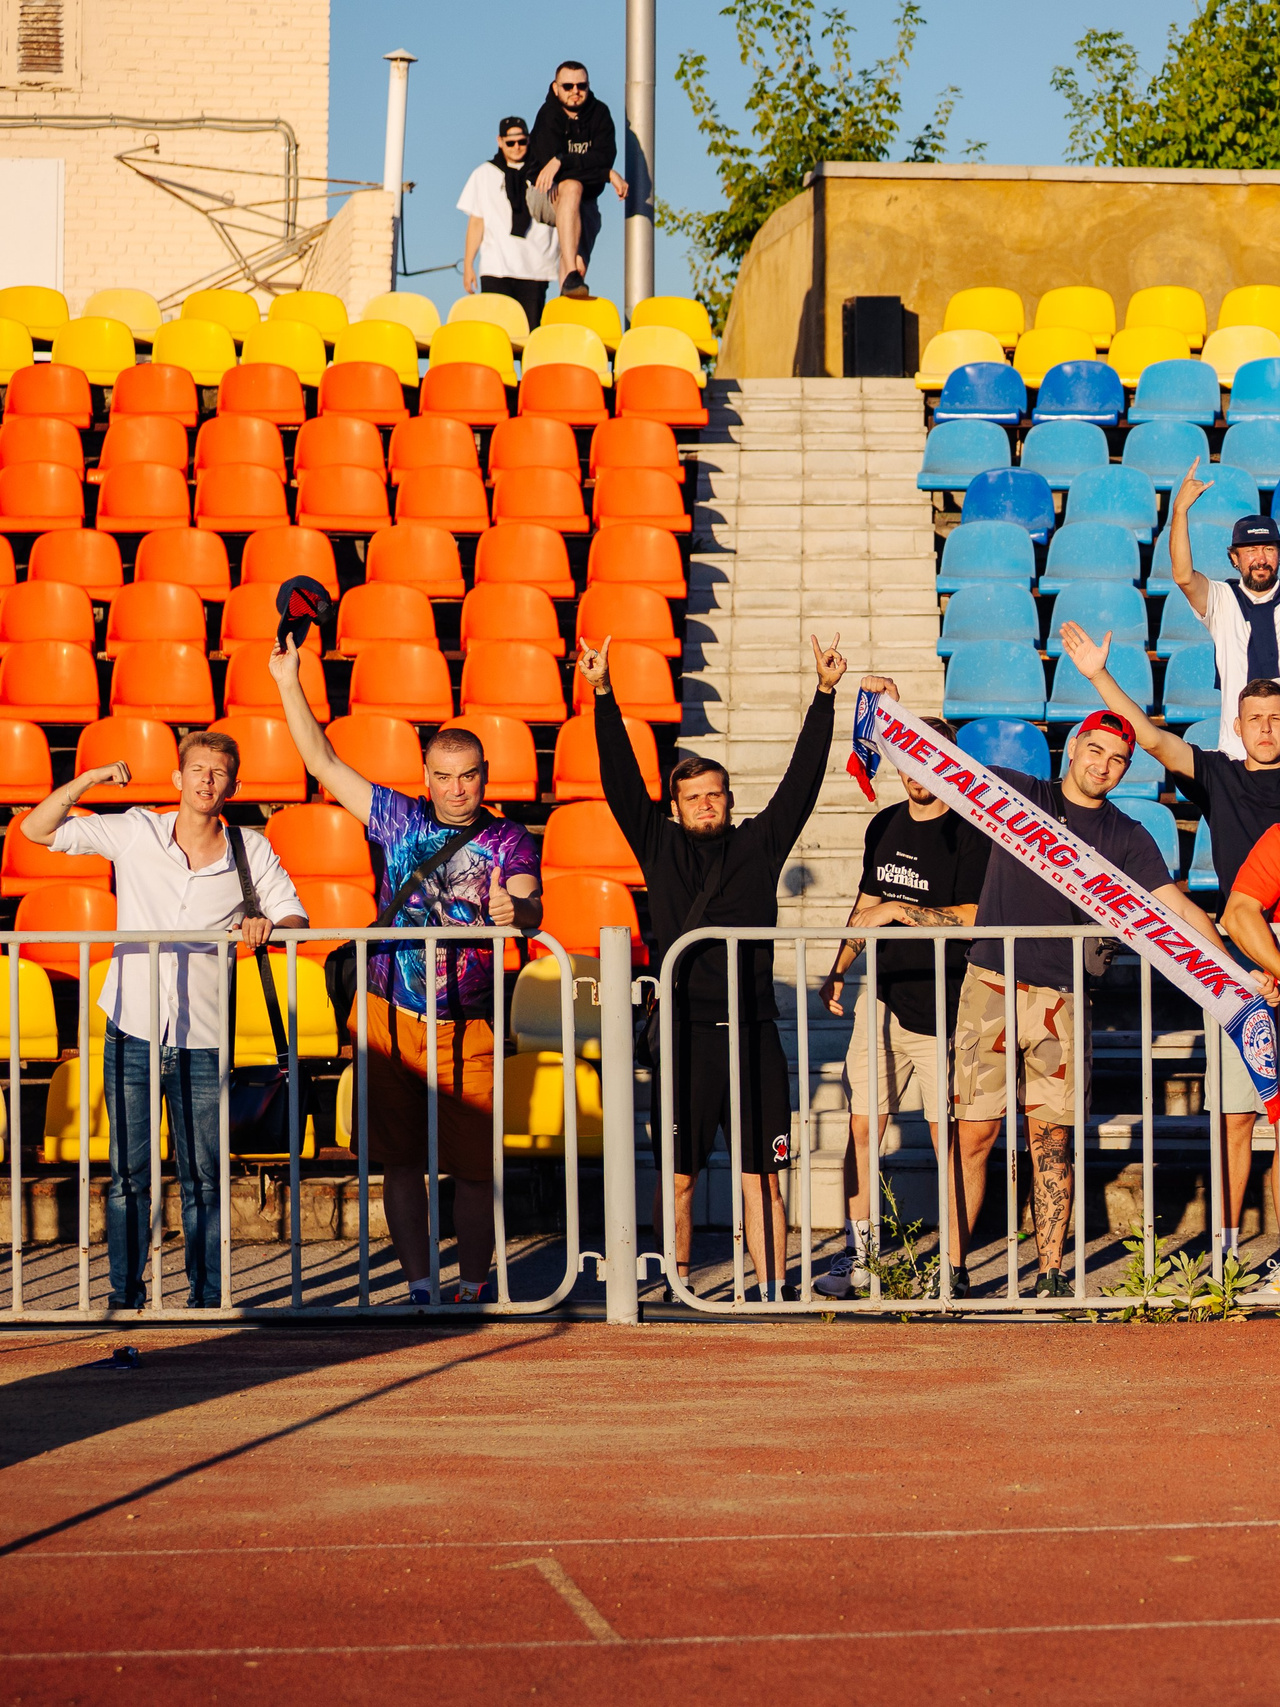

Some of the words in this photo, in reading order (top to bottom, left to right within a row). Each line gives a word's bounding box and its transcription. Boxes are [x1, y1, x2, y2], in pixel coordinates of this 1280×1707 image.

[969, 808, 1138, 942] MAGNITOGORSK
[982, 773, 1095, 862] FOOTBALL
[1111, 873, 1167, 917] CLUB
